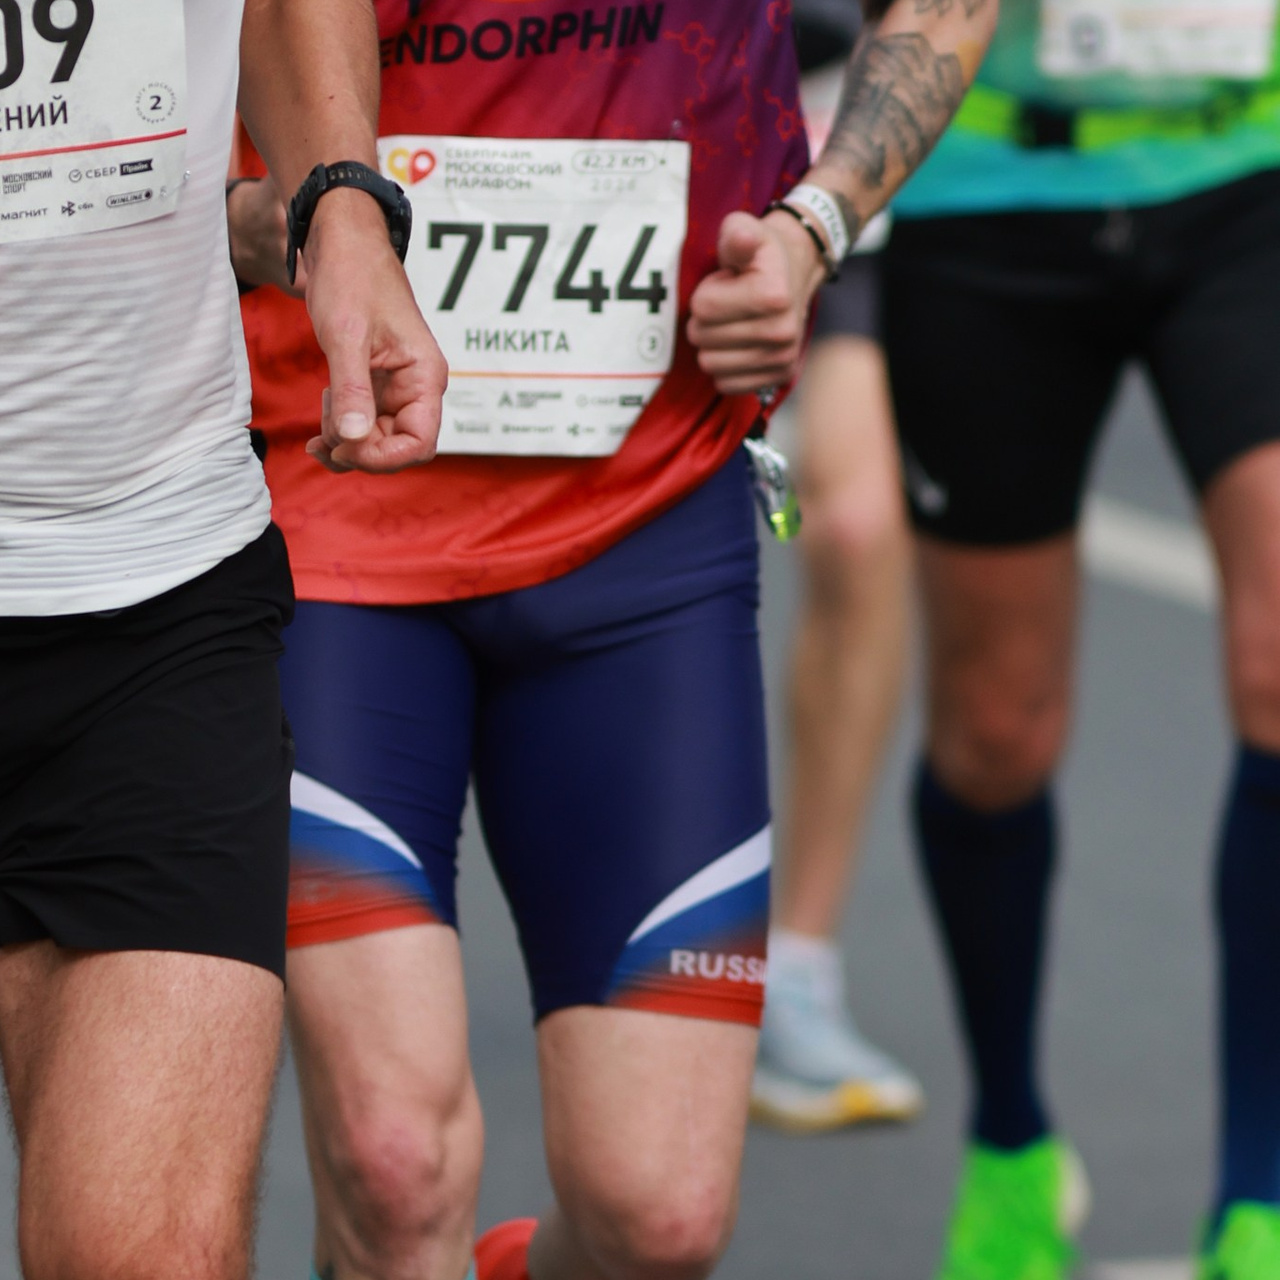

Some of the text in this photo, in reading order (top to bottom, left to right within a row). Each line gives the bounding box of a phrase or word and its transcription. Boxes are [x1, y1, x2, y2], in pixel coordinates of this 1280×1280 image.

[379, 1, 664, 70] ENDORPHIN
[149, 95, 162, 111] 2
[445, 161, 562, 176] МОСКОВСКИЙ
[581, 155, 615, 169] 42,2
[85, 167, 117, 179] СБЕР
[445, 176, 531, 190] МАРАФОН
[427, 221, 668, 314] 7744
[465, 329, 570, 353] НИКИТА
